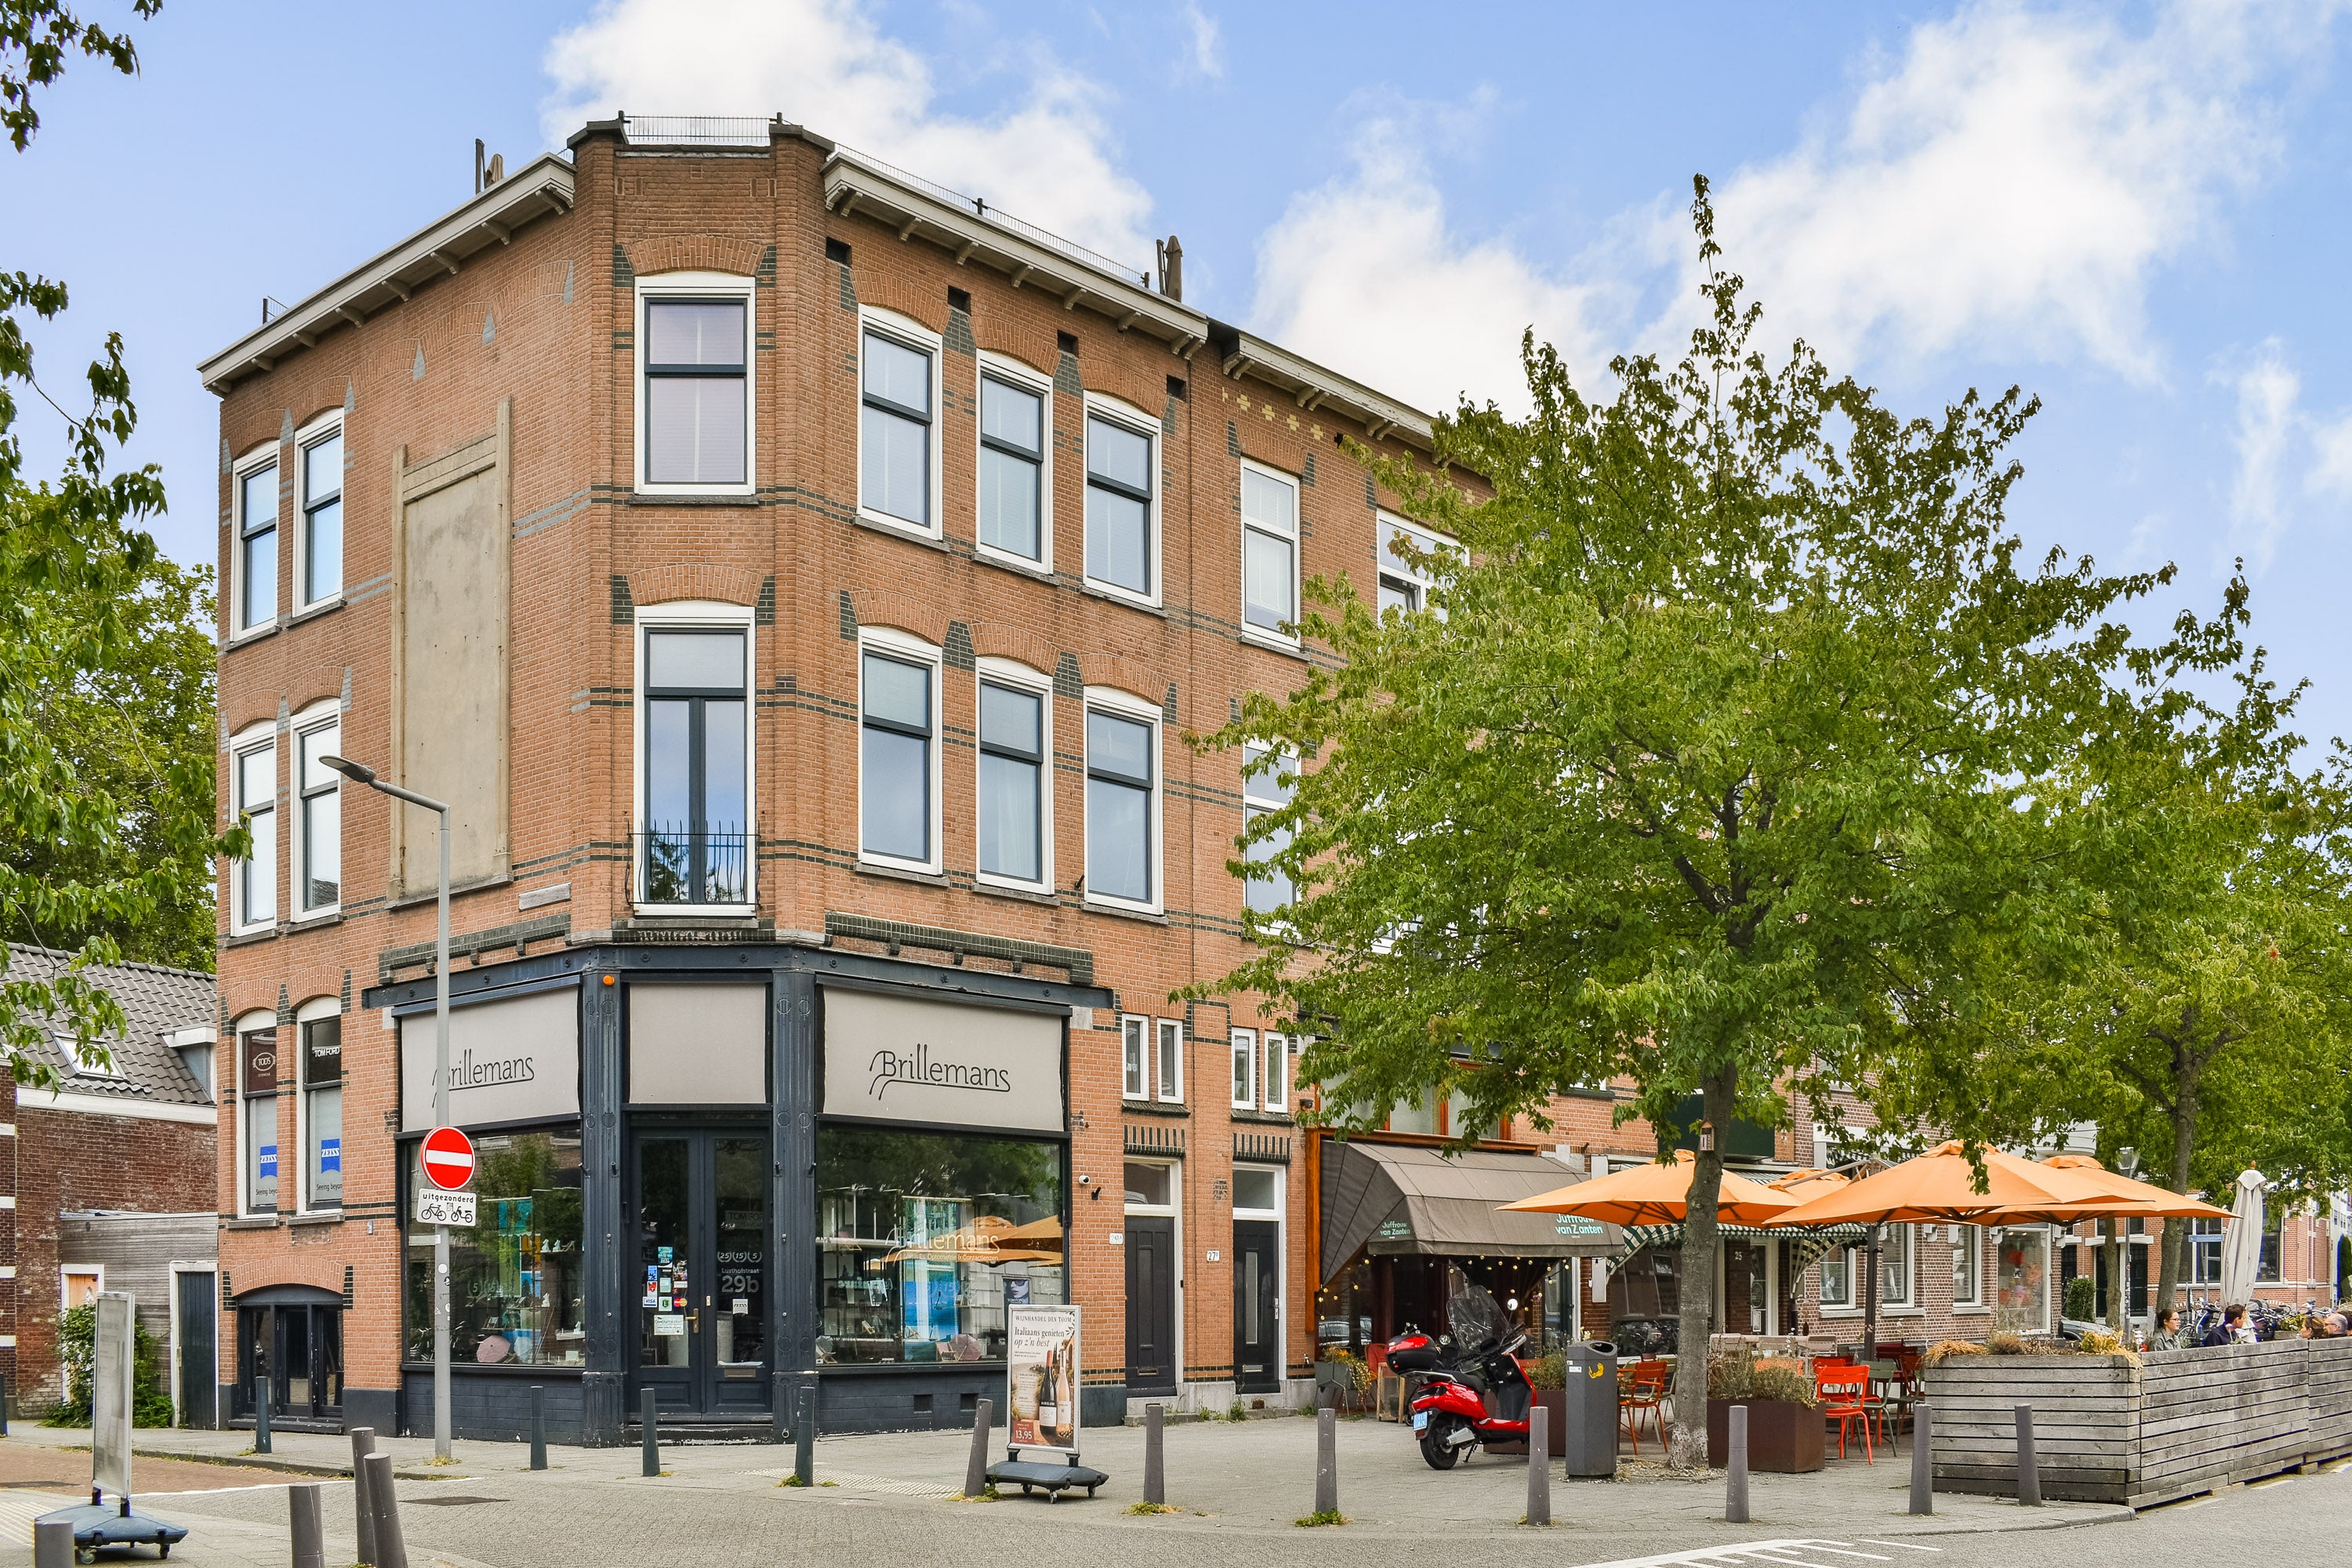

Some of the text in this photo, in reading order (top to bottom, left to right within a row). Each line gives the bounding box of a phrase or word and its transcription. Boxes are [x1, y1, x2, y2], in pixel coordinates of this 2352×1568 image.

[314, 1047, 340, 1058] TOM FORD
[869, 1044, 1011, 1100] Brillemans
[432, 1048, 535, 1109] rillemans
[321, 1148, 339, 1157] ZEISS
[260, 1154, 277, 1163] ZEISS
[423, 1193, 474, 1203] uitgezonderd
[1555, 1224, 1604, 1235] van Zanten
[1734, 1250, 1743, 1261] 25
[721, 1275, 760, 1293] 29b
[1014, 1327, 1065, 1338] Italiaans genieten
[1014, 1339, 1023, 1348] op
[1036, 1338, 1050, 1347] best
[1015, 1429, 1033, 1440] 13,95
